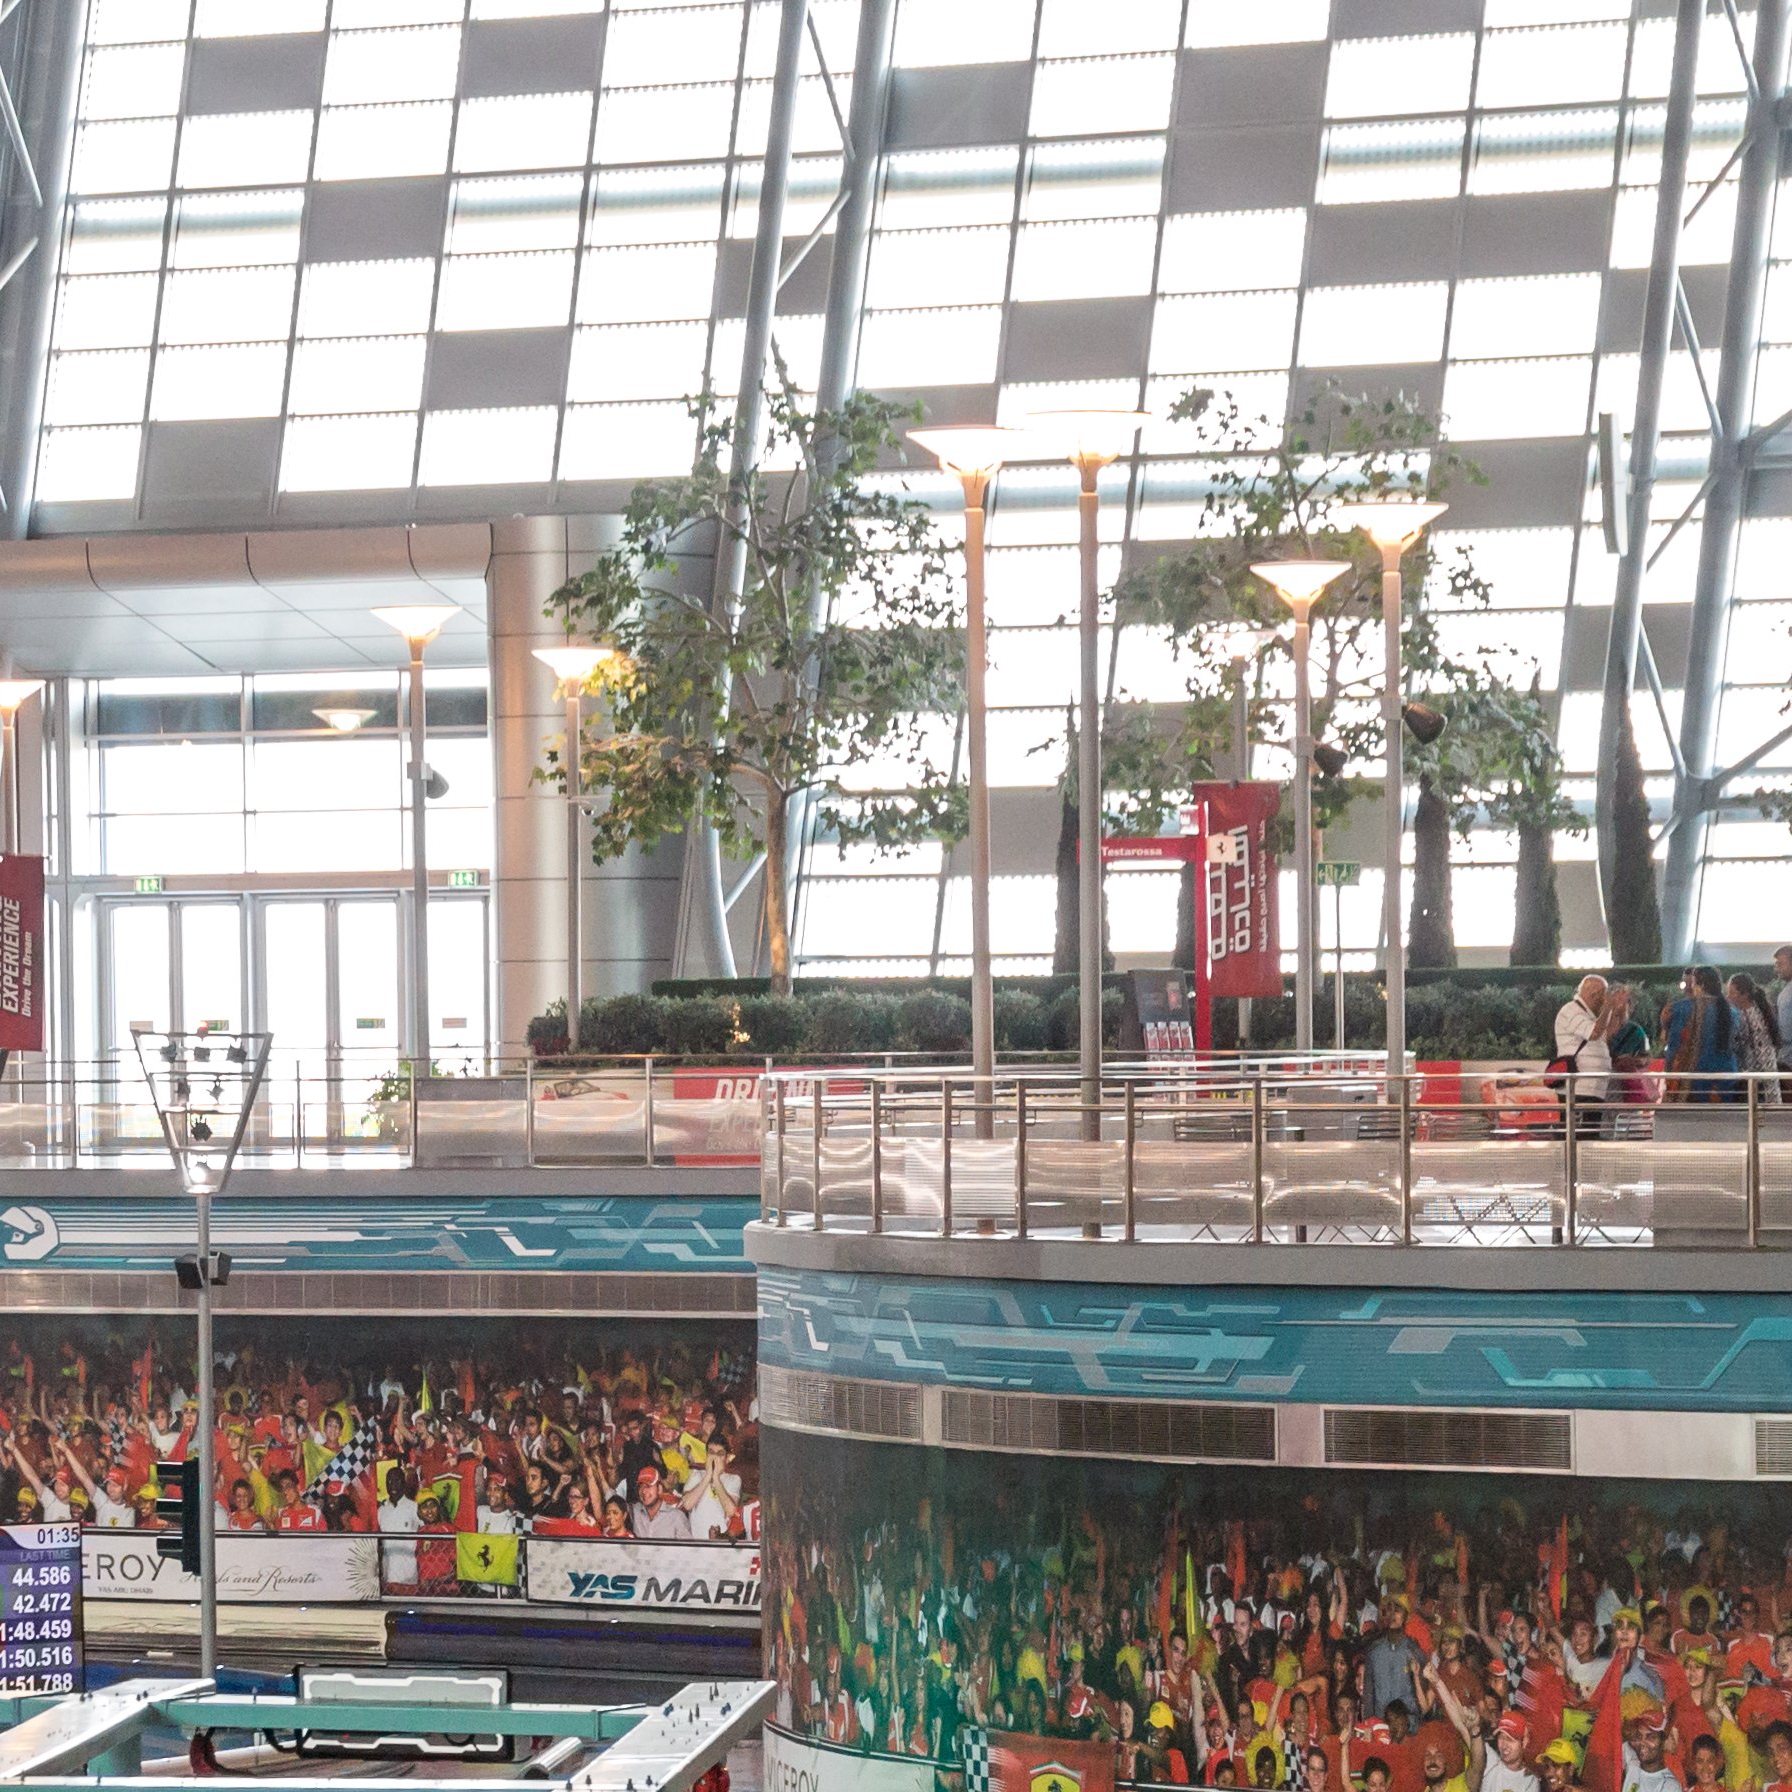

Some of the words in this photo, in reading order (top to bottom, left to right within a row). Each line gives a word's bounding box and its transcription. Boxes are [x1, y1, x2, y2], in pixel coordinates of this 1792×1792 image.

[1101, 846, 1163, 857] Testarossa
[3, 896, 20, 1013] EXPERIENCE
[22, 931, 32, 966] Dream
[22, 969, 32, 986] the
[22, 988, 32, 1017] Drive
[37, 1527, 80, 1544] 01:35
[20, 1551, 46, 1561] LAST
[12, 1566, 71, 1587] 44.586
[567, 1571, 638, 1600] YAS
[641, 1577, 761, 1606] MARI
[13, 1593, 71, 1613] 42.472
